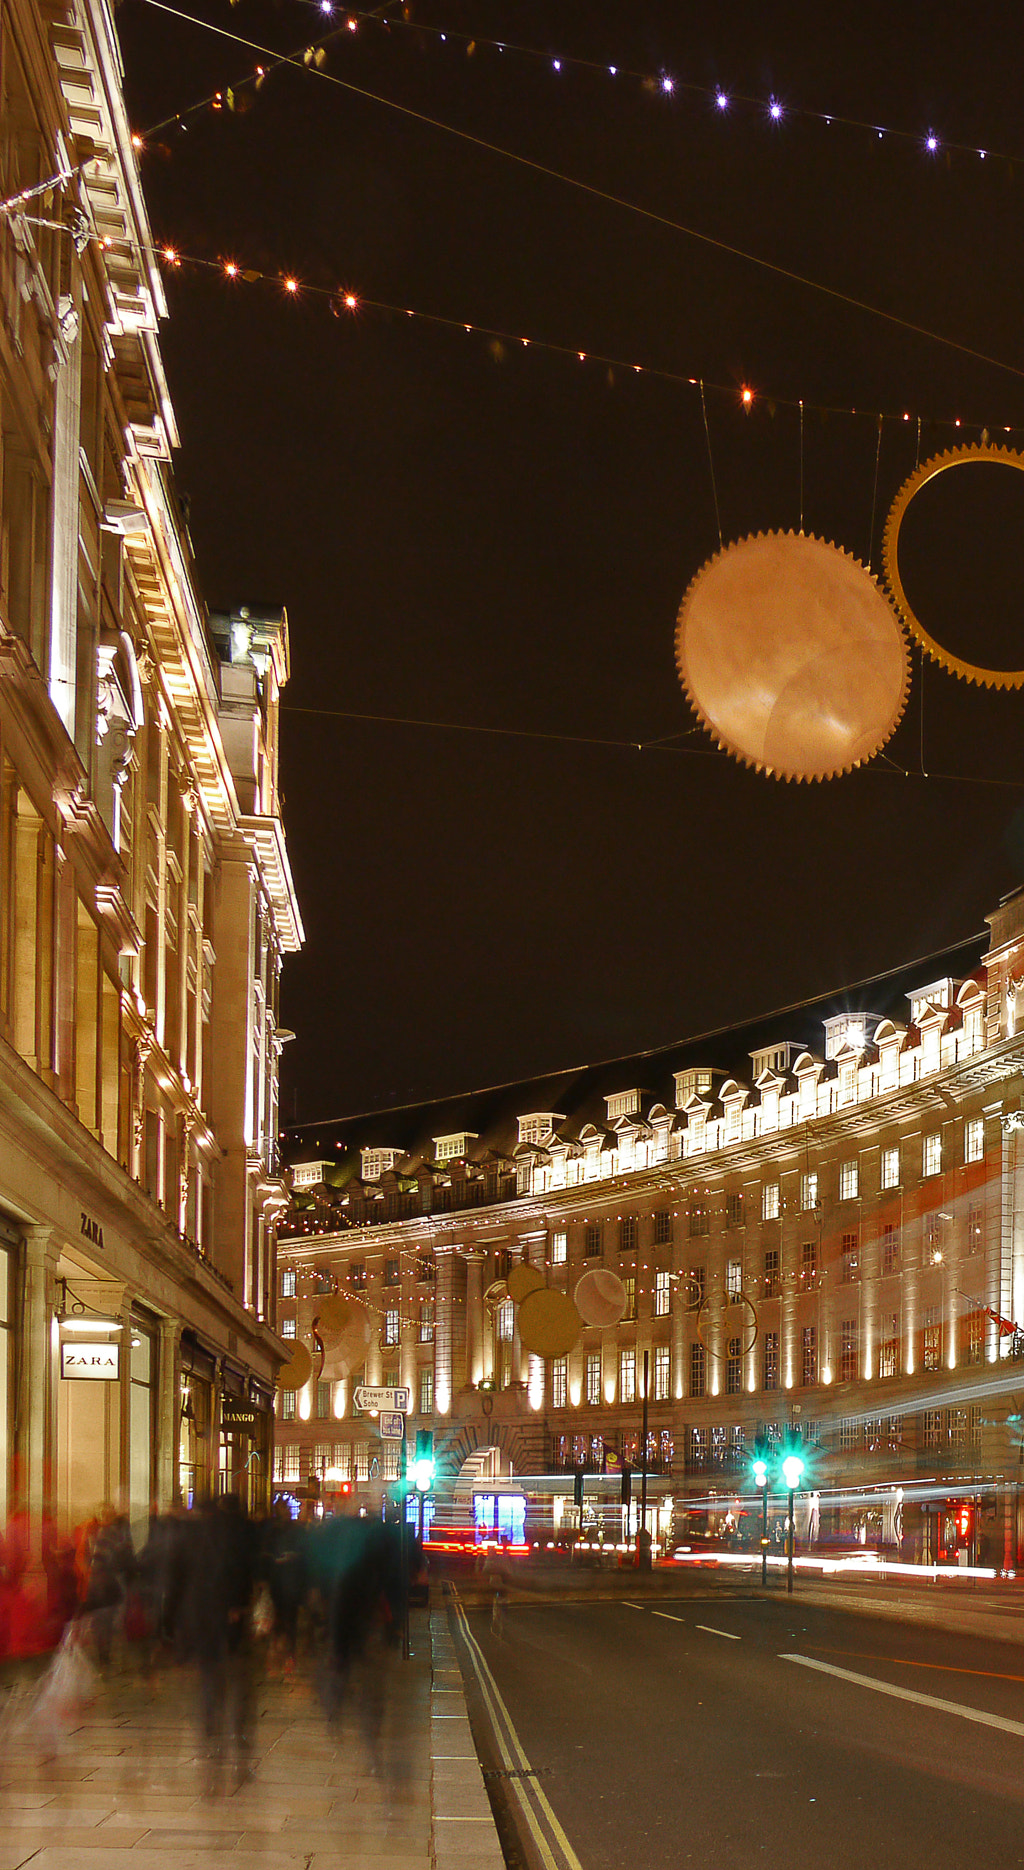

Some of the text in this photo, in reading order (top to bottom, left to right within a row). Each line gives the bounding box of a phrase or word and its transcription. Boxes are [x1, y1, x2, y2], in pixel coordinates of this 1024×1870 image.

[80, 1212, 104, 1249] ZARA
[65, 1356, 115, 1366] ZARA
[362, 1390, 393, 1399] Brewer St
[363, 1399, 378, 1408] Soho
[397, 1393, 405, 1407] P
[223, 1413, 255, 1422] MANGO
